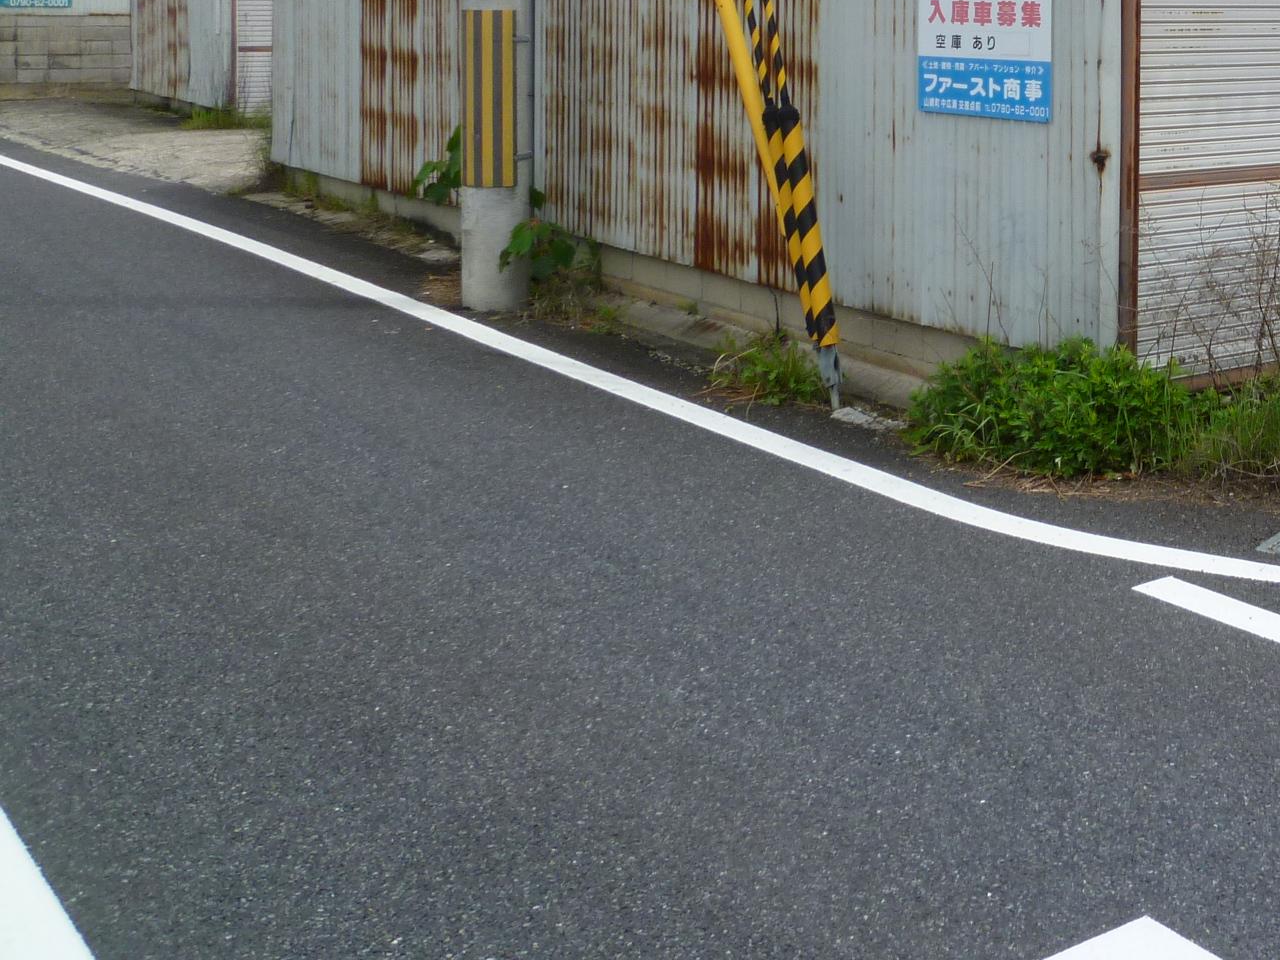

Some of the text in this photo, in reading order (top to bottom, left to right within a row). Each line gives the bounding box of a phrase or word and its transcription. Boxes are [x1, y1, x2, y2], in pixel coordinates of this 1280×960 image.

[928, 0, 1041, 28] 入庫車募集
[936, 34, 996, 50] 空庫 あり
[923, 73, 1042, 102] ファースト商事
